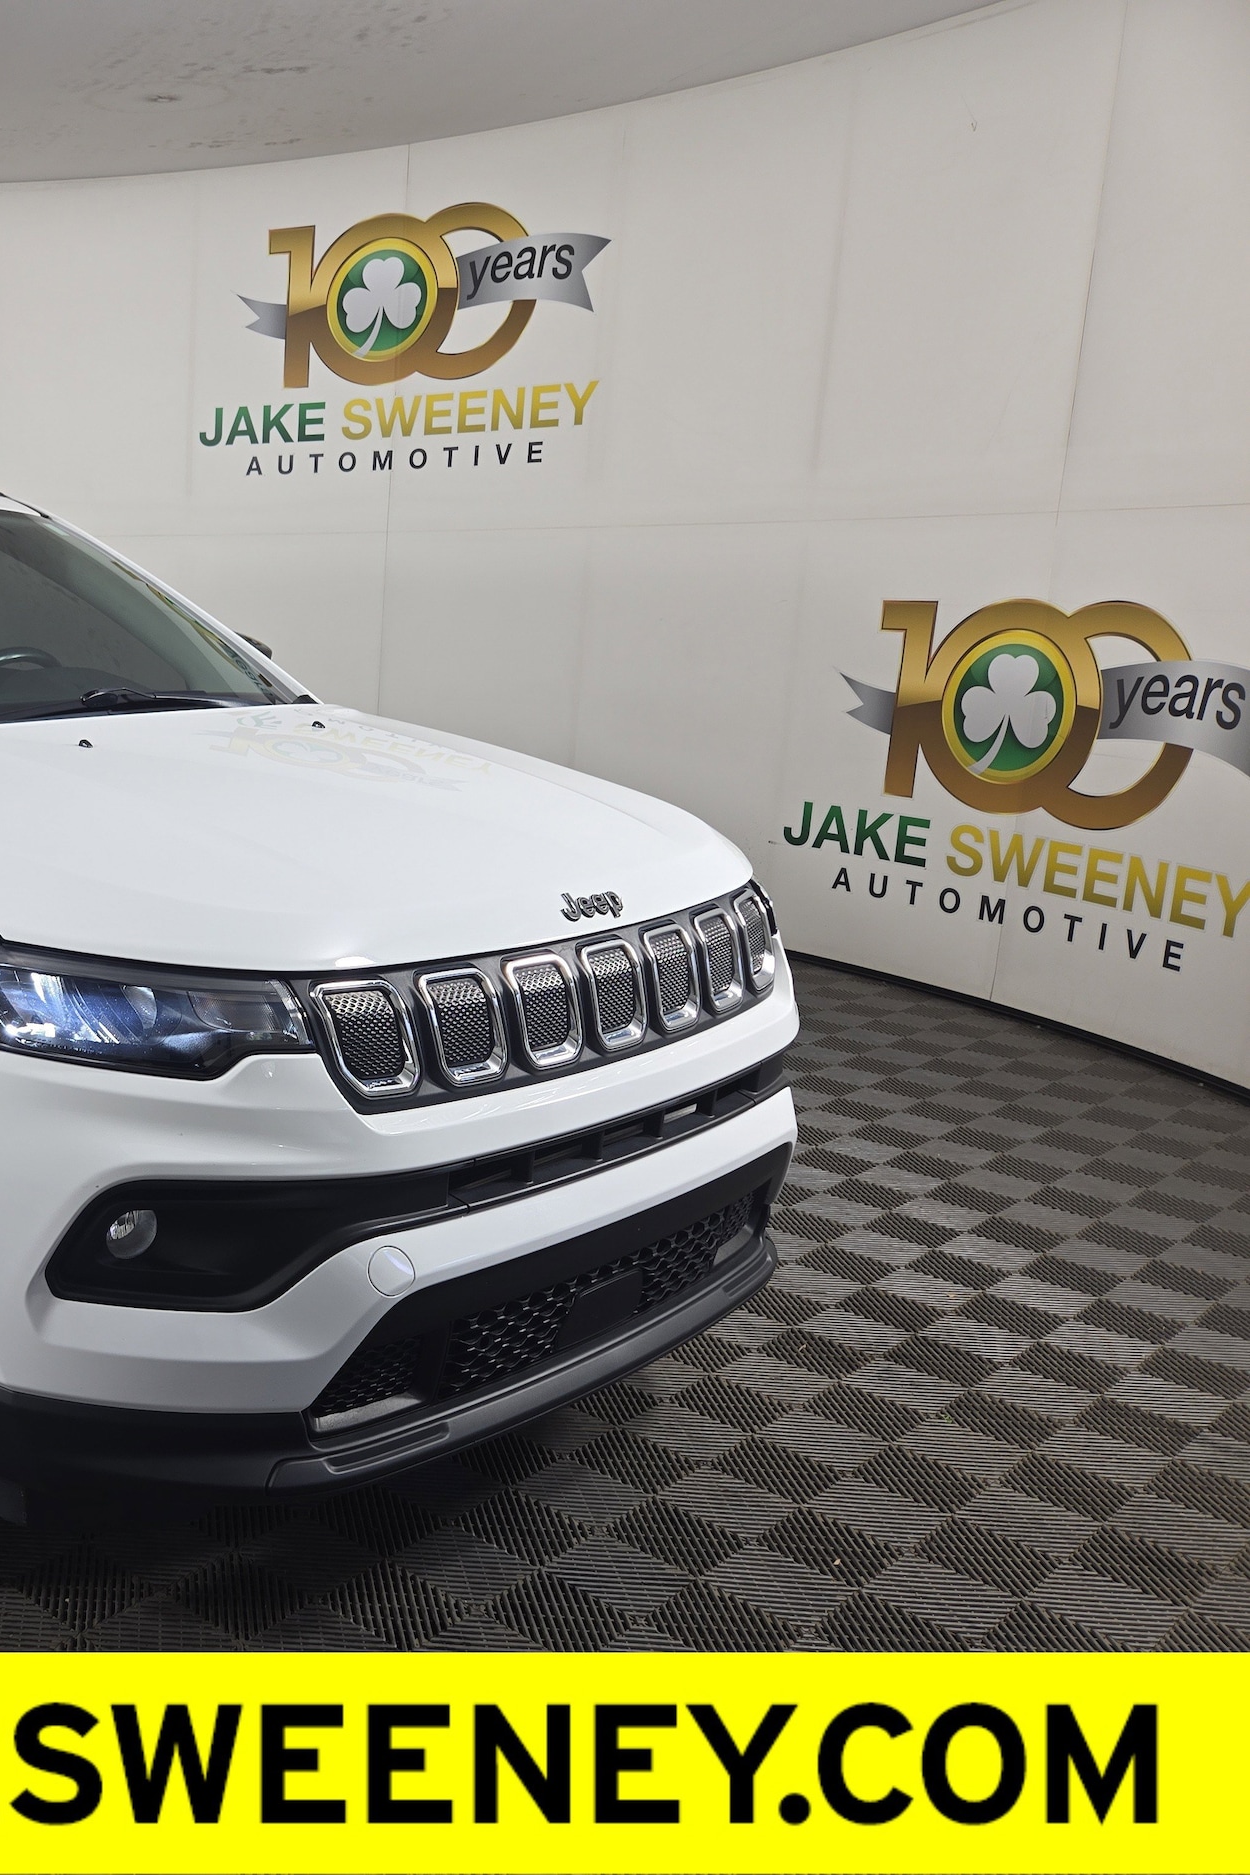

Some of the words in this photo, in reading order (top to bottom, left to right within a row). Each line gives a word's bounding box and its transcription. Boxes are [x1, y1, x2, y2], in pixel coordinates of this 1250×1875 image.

[466, 241, 575, 300] years
[199, 401, 327, 448] JAKE
[341, 380, 600, 441] SWEENEY
[245, 441, 545, 477] AUTOMOTIVE
[1108, 672, 1247, 731] years
[783, 801, 932, 868] JAKE
[946, 824, 1250, 938] SWEENEY
[560, 891, 624, 922] Jeep
[832, 867, 1185, 972] AUTOMOTIVE
